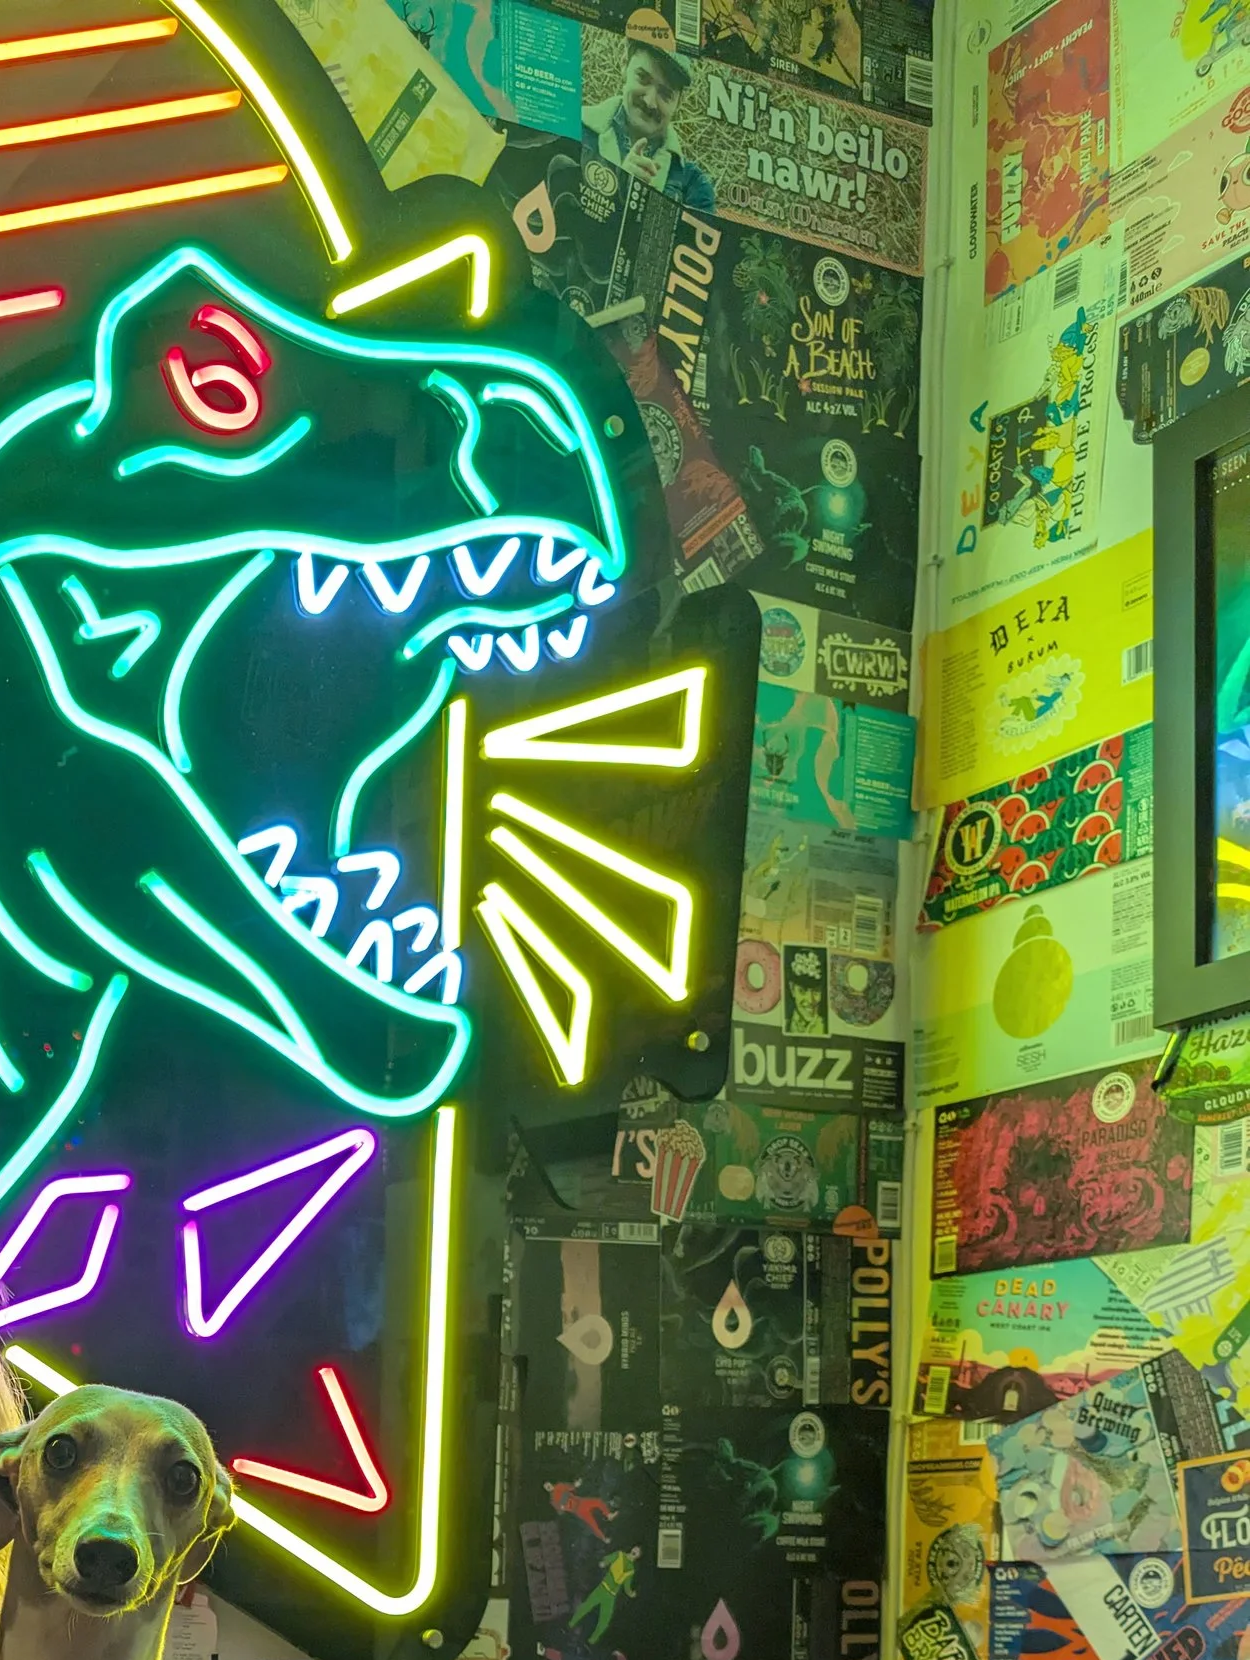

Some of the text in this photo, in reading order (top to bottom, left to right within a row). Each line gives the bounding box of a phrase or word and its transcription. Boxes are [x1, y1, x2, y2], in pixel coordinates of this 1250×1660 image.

[770, 56, 799, 74] SIREN
[707, 75, 908, 179] Ni'n beilo
[1078, 110, 1092, 186] HAZY PALE
[747, 147, 868, 214] nawr!
[968, 181, 978, 260] CLOUDWATER
[658, 210, 722, 395] POLLY'S
[791, 296, 864, 350] SON OF
[803, 339, 877, 381] BEACH
[989, 605, 1071, 667] DEYA
[1007, 640, 1060, 675] BURUM
[831, 646, 896, 681] CWRW
[732, 1027, 855, 1092] buzz
[1081, 1119, 1147, 1149] PARADISO
[975, 1298, 1071, 1322] CANARY
[994, 1277, 1058, 1297] DEAD
[851, 1237, 890, 1406] POLLY'S
[989, 1321, 1011, 1332] WEST
[1011, 1322, 1037, 1332] COAST
[1076, 1406, 1142, 1442] Brewing
[1093, 1389, 1138, 1418] Queer
[1102, 1583, 1156, 1660] CARTEN
